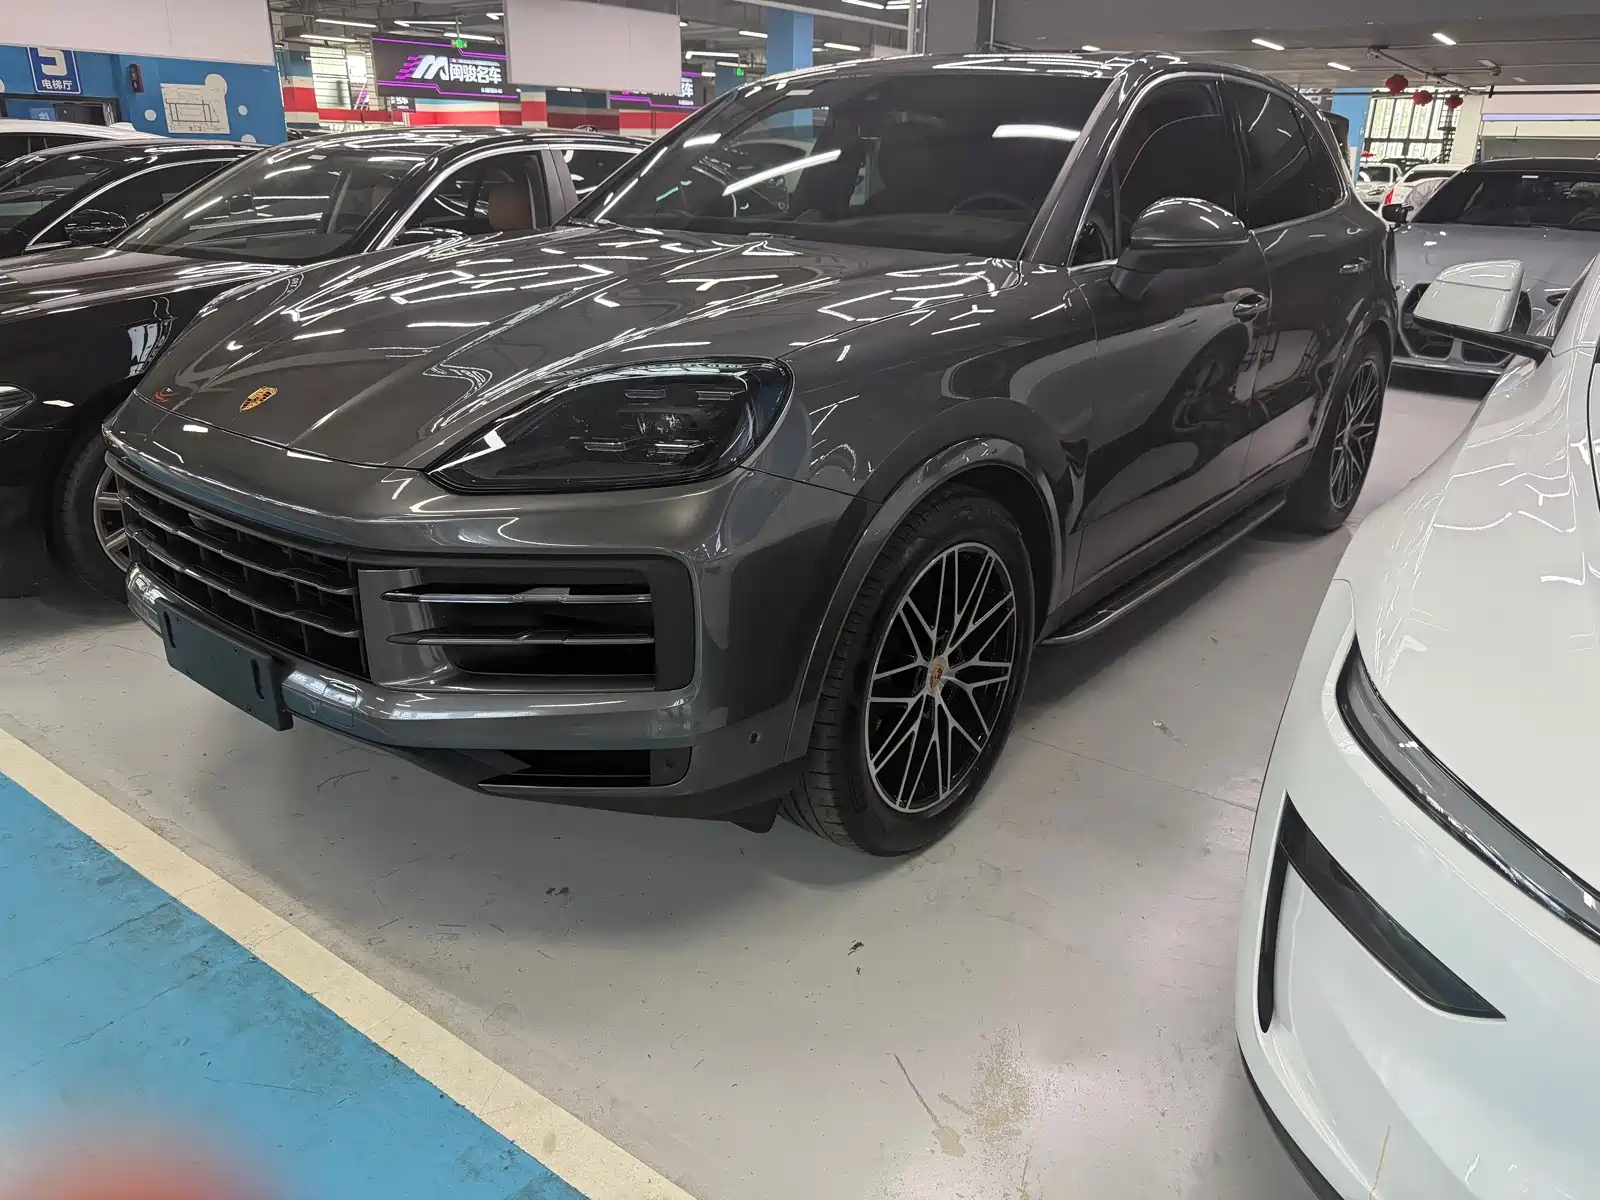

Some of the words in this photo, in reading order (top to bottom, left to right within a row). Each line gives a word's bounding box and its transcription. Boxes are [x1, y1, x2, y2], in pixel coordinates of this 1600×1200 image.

[450, 63, 502, 84] 闽骏名车
[41, 79, 72, 90] 电梯厅
